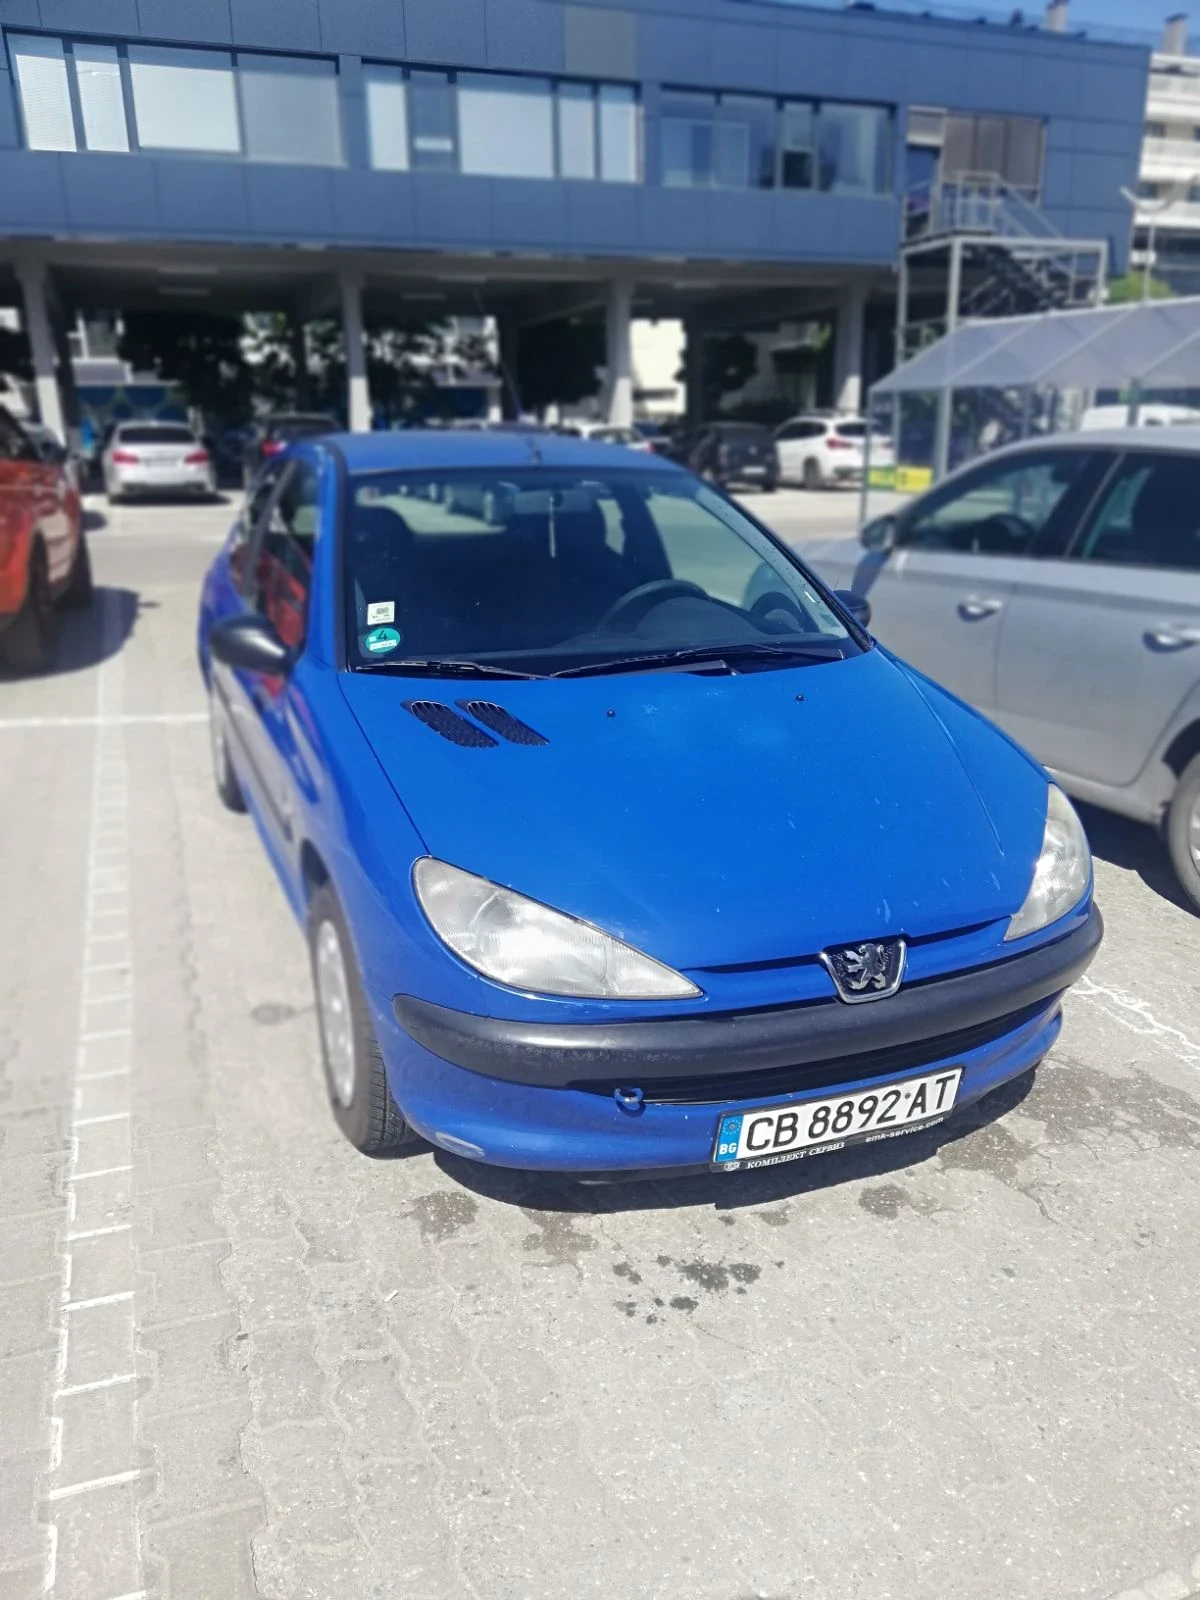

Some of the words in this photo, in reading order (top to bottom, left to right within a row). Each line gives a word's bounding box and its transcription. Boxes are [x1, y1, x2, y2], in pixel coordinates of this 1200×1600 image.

[377, 629, 387, 641] 4
[746, 1112, 799, 1151] CB
[808, 1089, 901, 1139] 8892
[906, 1075, 956, 1118] AT
[865, 1117, 944, 1143] emk-service.com
[719, 1143, 737, 1155] BG
[747, 1151, 806, 1169] КОМПЛЕКТ
[809, 1142, 845, 1156] СЕРВИЗ
